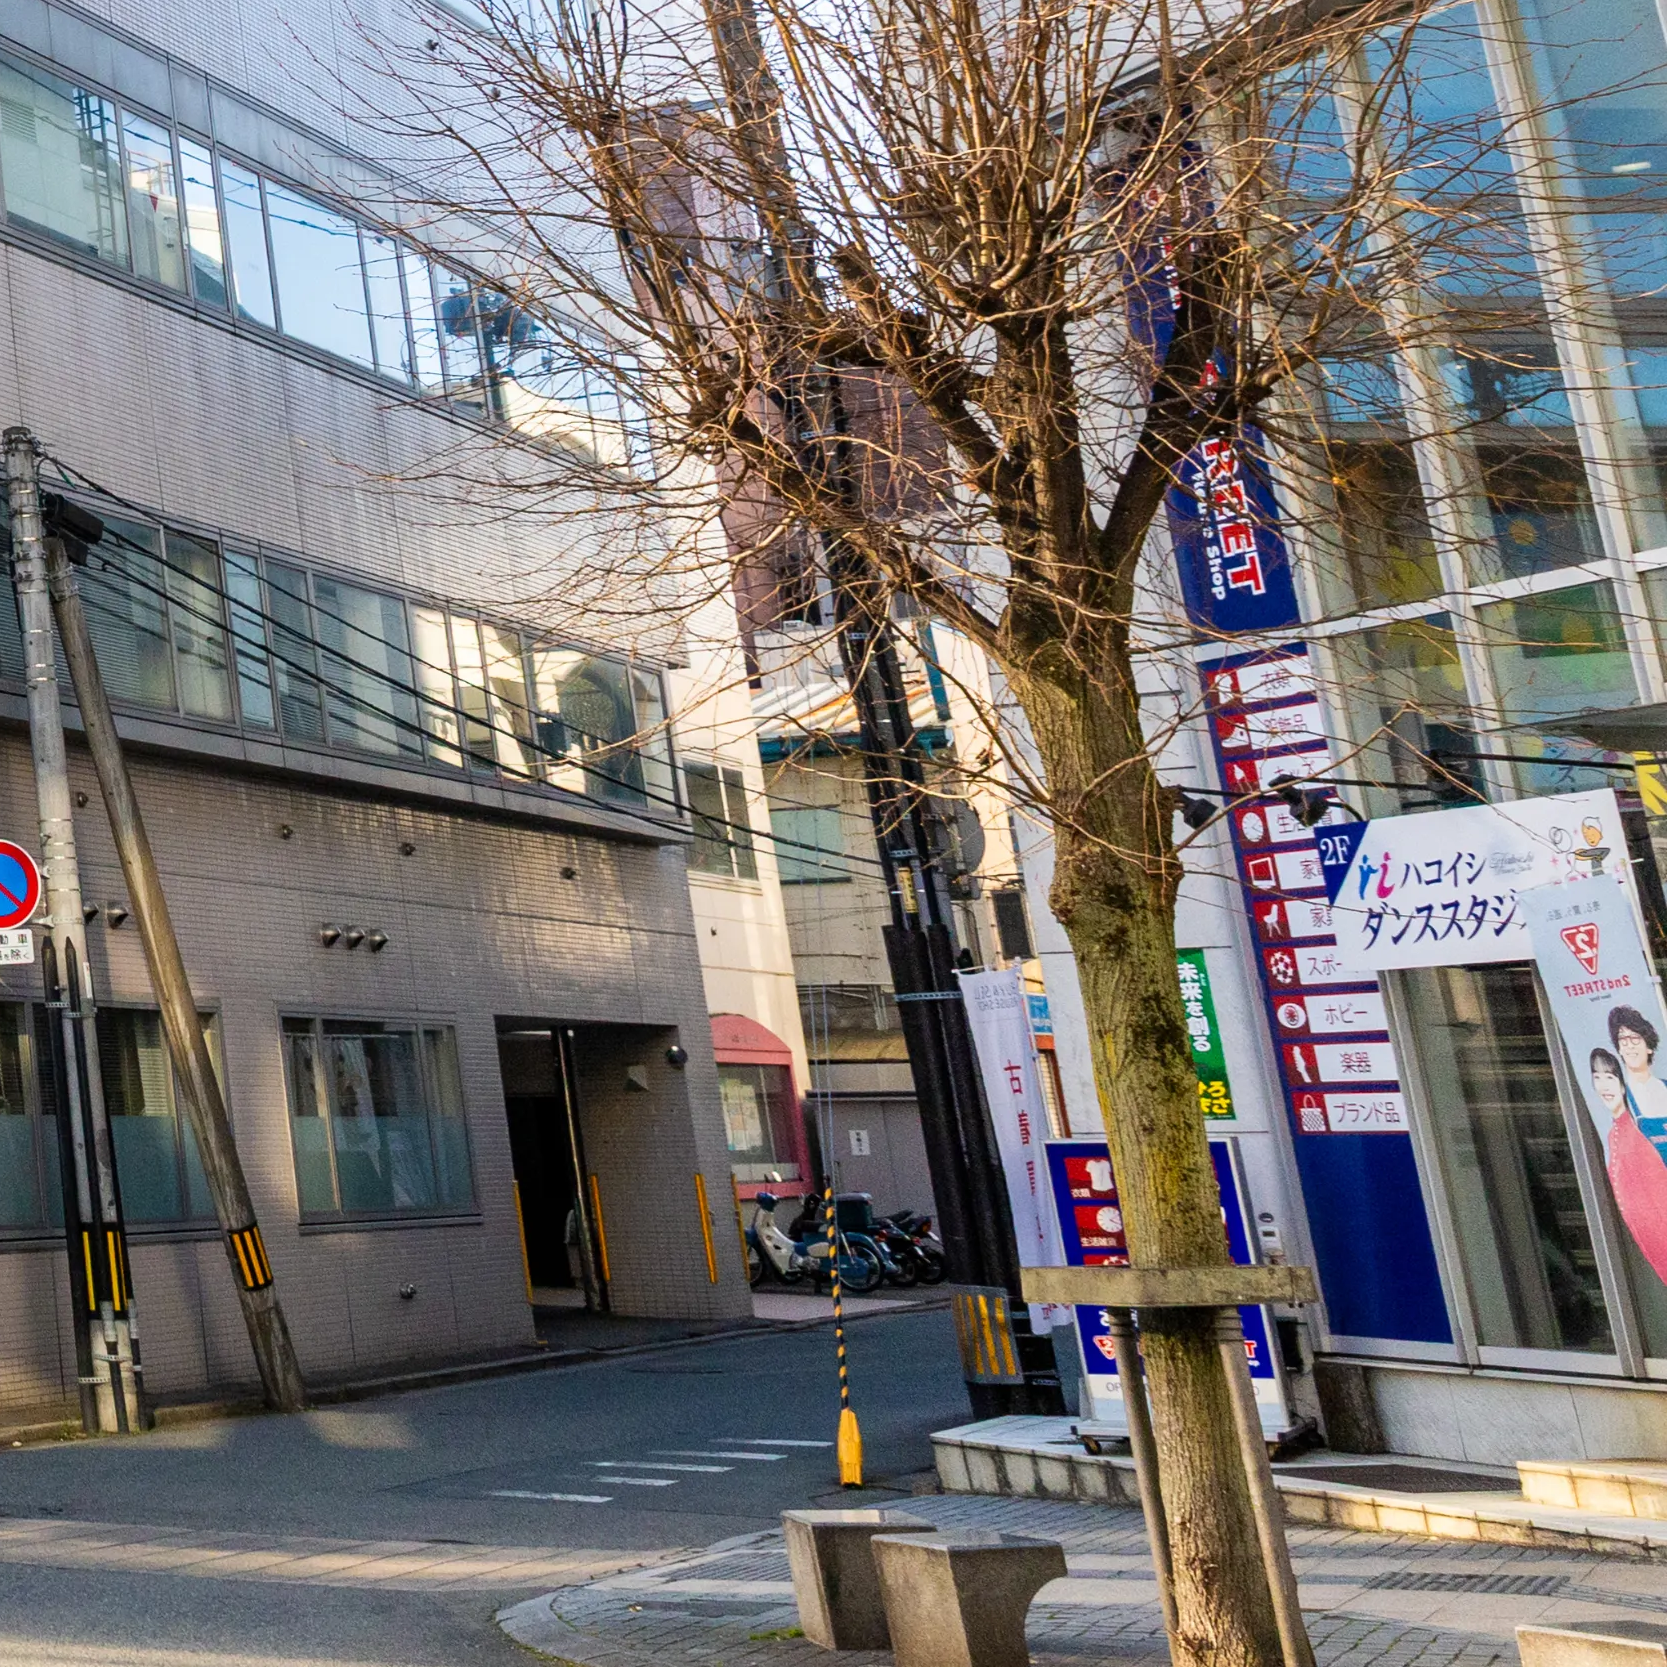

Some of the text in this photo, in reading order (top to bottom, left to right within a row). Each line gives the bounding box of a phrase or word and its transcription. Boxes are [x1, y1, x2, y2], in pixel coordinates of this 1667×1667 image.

[1205, 545, 1228, 601] Shop
[1320, 835, 1351, 866] 2F
[1399, 851, 1488, 889] ハコイシ
[1323, 1003, 1369, 1026] ホビー
[1340, 1050, 1372, 1075] 楽器
[1332, 1100, 1401, 1125] ブランド品
